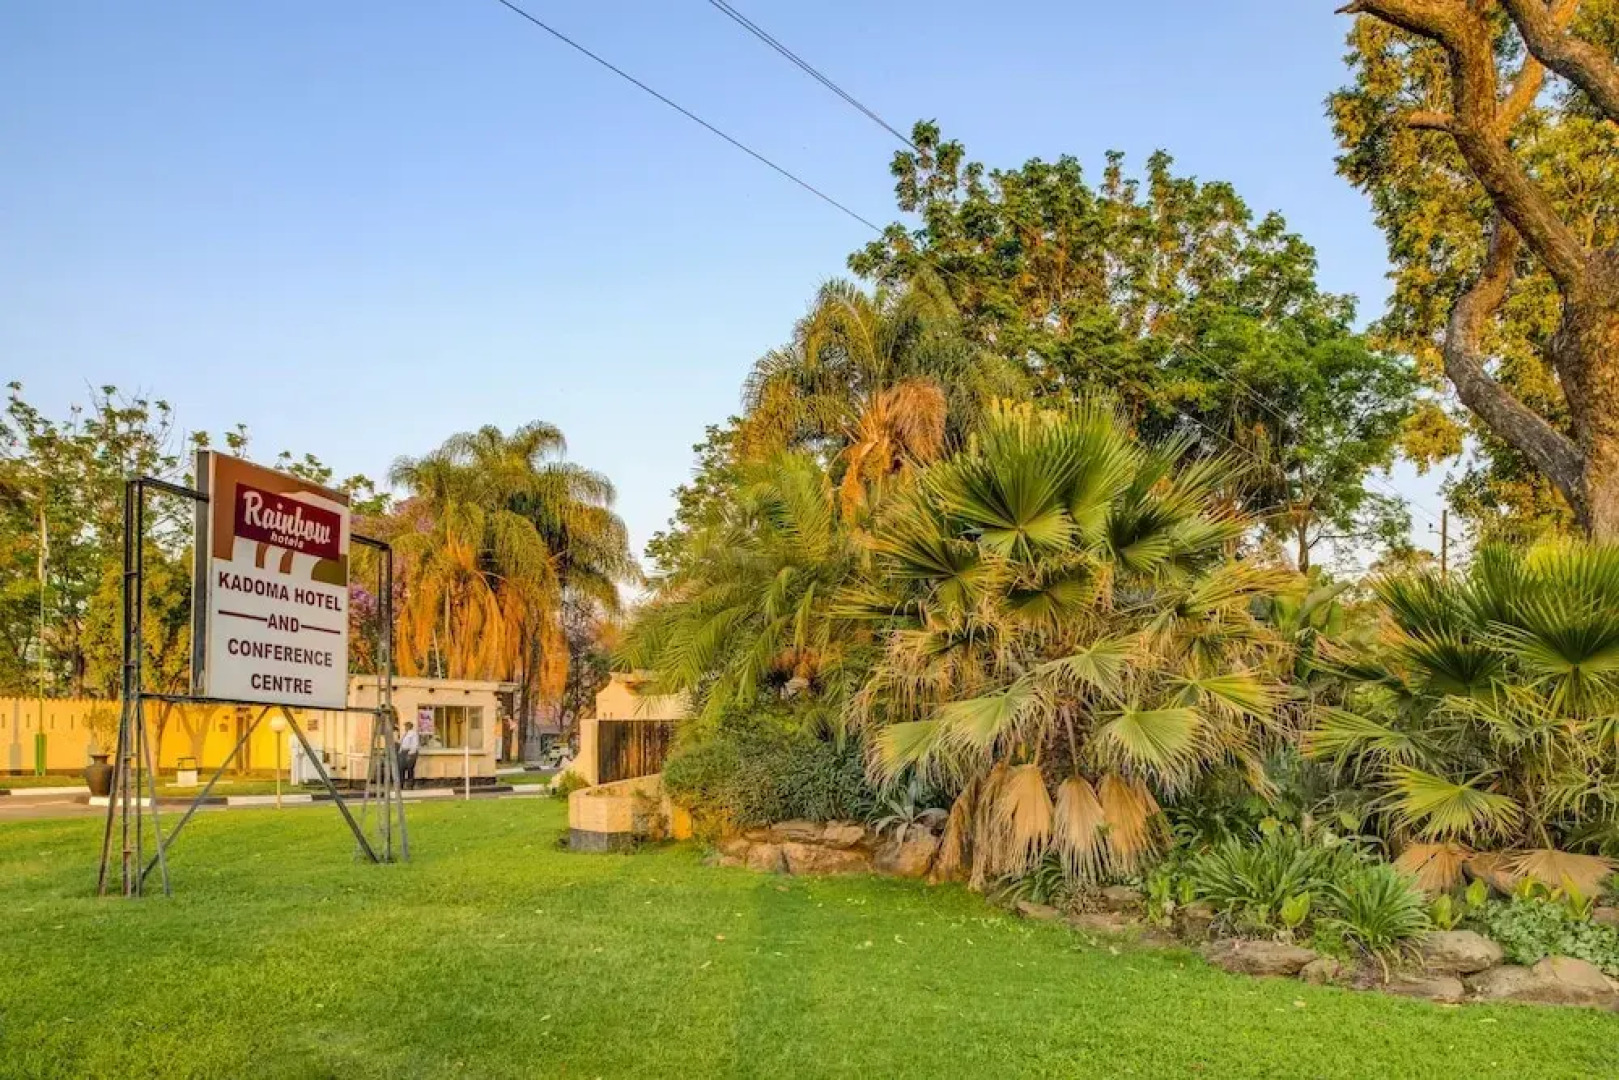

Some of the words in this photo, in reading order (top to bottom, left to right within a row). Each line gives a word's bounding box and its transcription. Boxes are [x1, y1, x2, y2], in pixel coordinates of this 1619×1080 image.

[243, 491, 331, 545] Rainbow
[270, 531, 304, 549] hotels
[218, 571, 289, 601] KADOMA
[294, 588, 342, 611] HOTEL
[267, 613, 299, 633] AND
[227, 638, 333, 667] CONFERENCE
[251, 673, 313, 694] CENTRE
